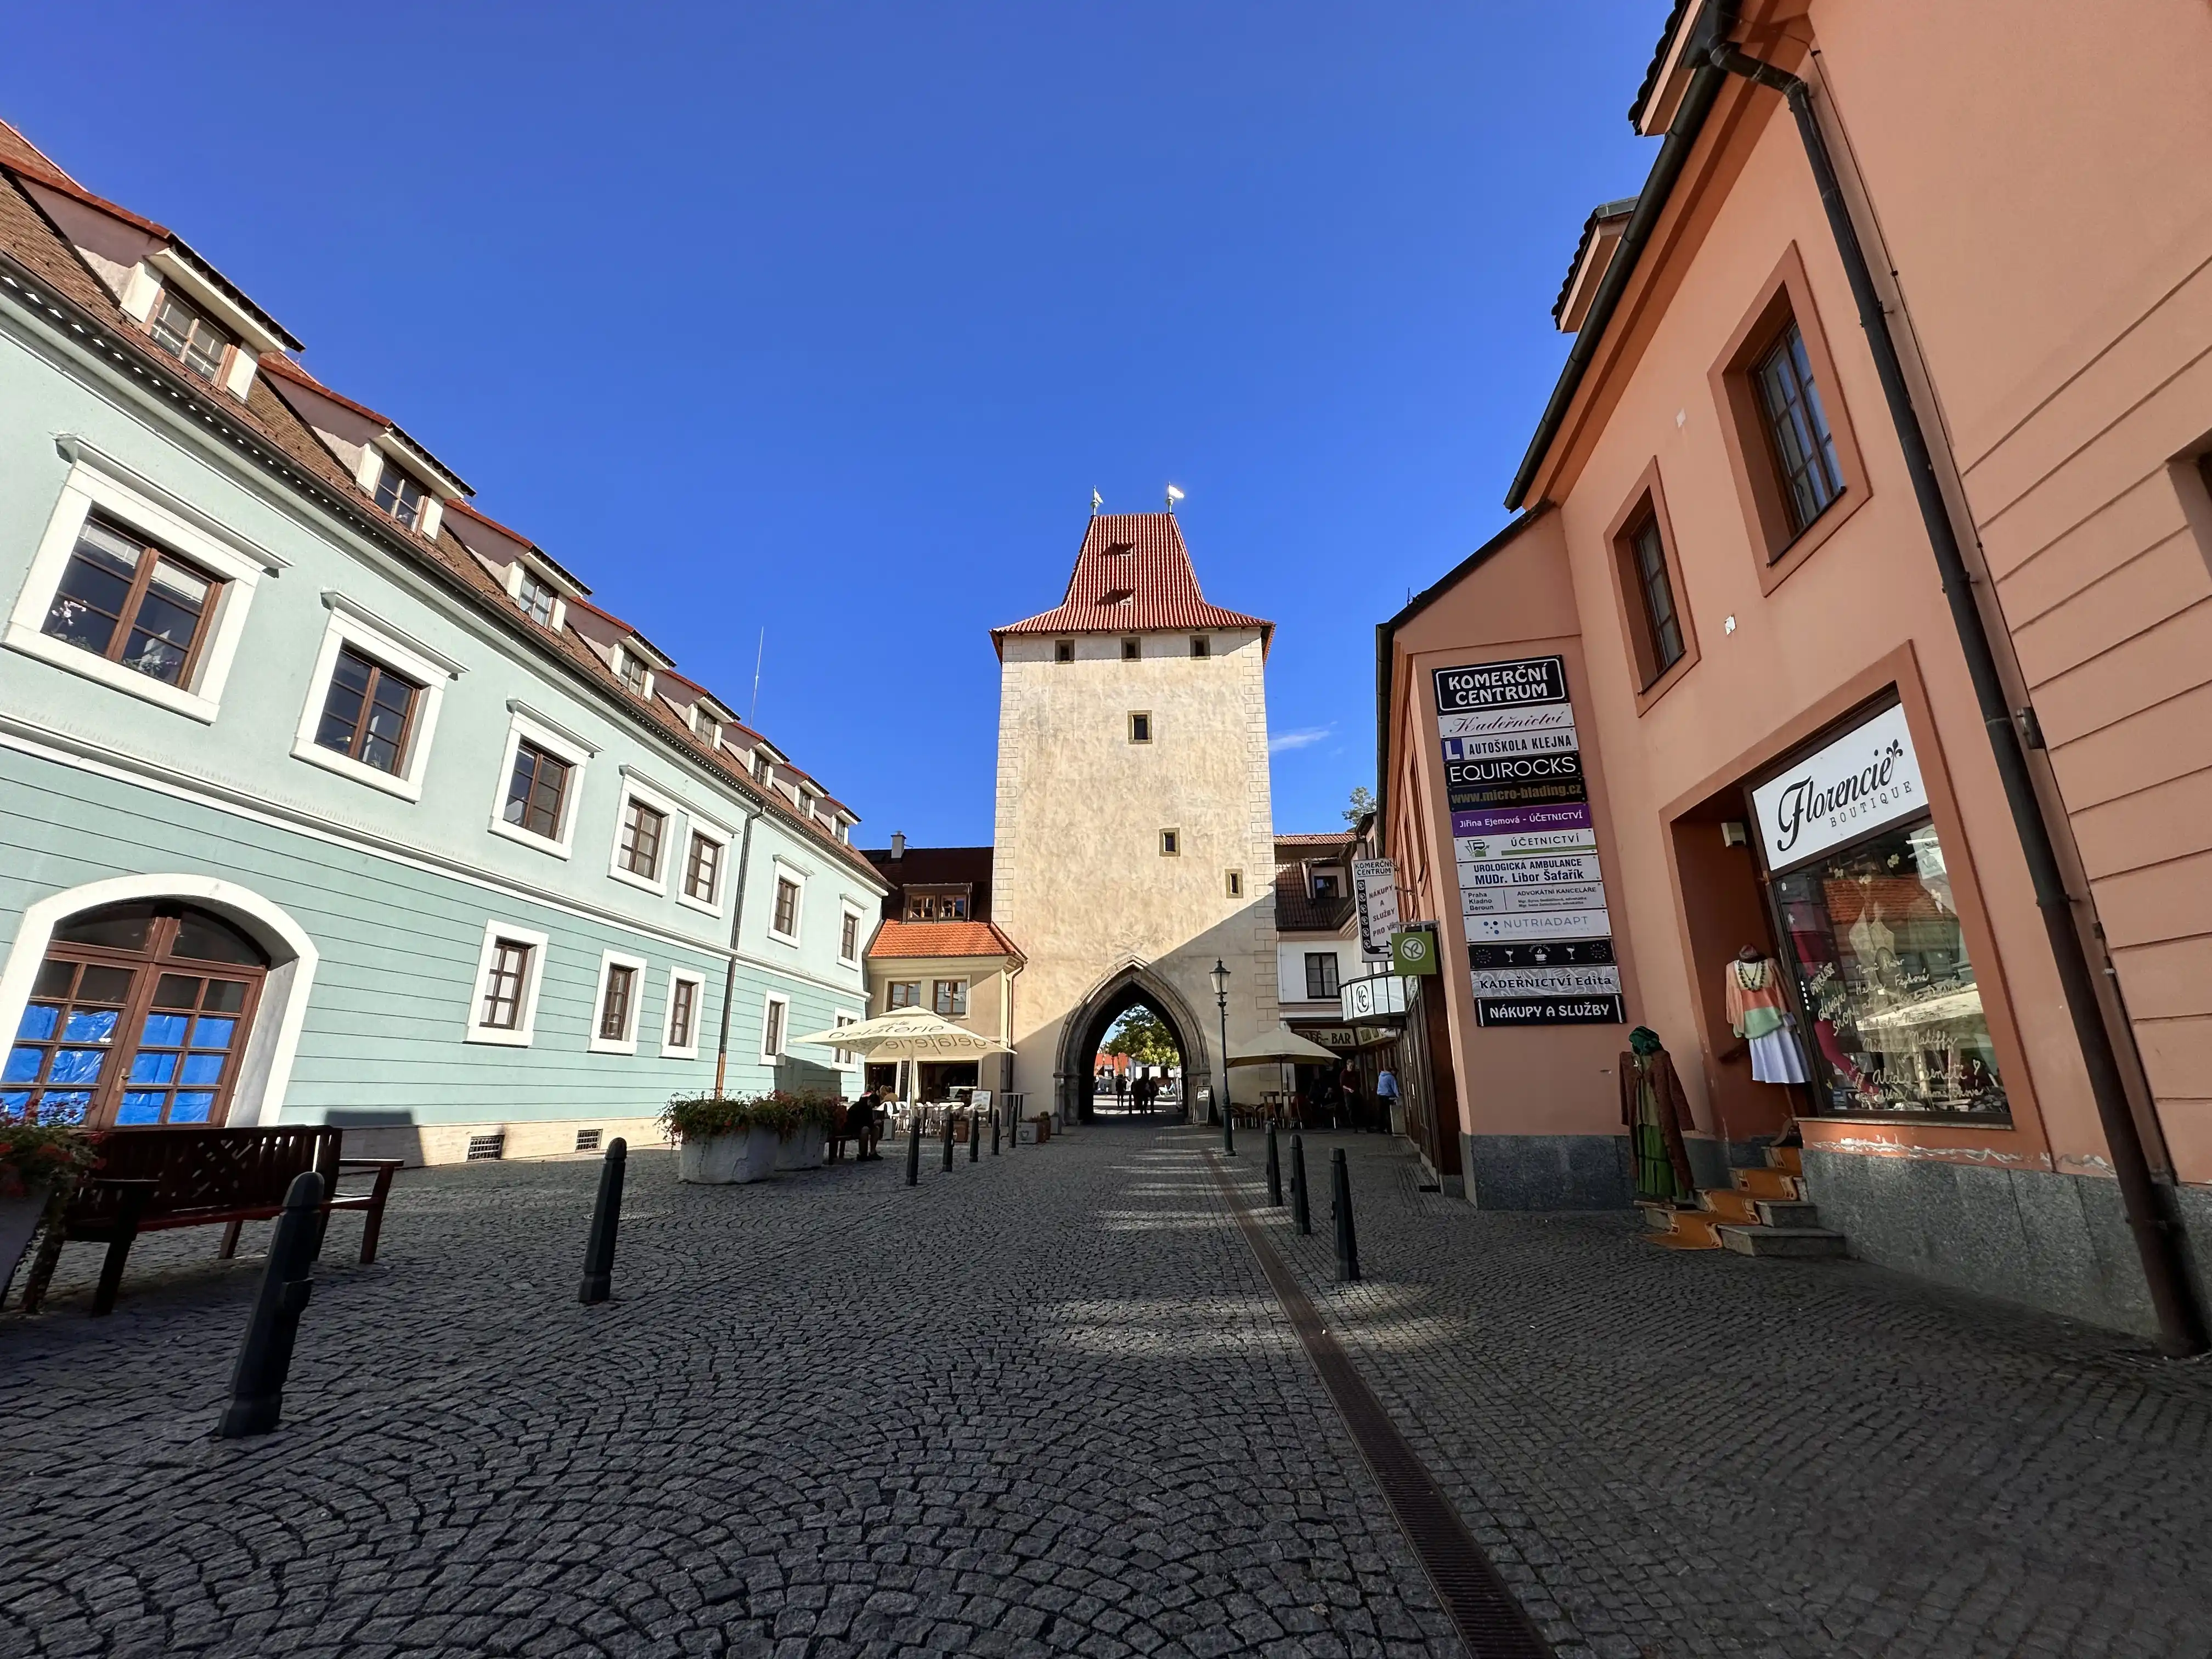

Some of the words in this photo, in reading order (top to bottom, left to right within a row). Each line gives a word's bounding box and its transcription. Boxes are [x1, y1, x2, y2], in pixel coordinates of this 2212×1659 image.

[1448, 663, 1549, 690] KOMERČNÍ
[1455, 683, 1548, 706] CENTRUM
[1449, 712, 1565, 733] Kadeřnictví
[1469, 739, 1528, 755] AUTOŠKOLA
[1532, 735, 1572, 750] KLEJNA
[1449, 757, 1576, 782] EQUIROCKS
[1451, 783, 1582, 804] www.micro-blading.cz
[1777, 749, 1895, 851] Florencie
[1830, 781, 1912, 827] BOUTIQUE
[1459, 819, 1482, 828] Jiřina
[1485, 815, 1520, 827] Ejemová
[1529, 810, 1583, 822] ÚČETNICTVÍ
[1510, 832, 1580, 847] ÚČETNICTVÍ
[1355, 860, 1393, 869] KOMERČNÍ
[1357, 867, 1391, 876] CENTRUM
[1473, 859, 1526, 873] UROLOGICKÁ
[1530, 858, 1582, 870] AMBULANCE
[1475, 872, 1508, 885] MUDr.
[1512, 871, 1540, 883] Libor
[1544, 868, 1584, 882] Šafařík
[1369, 884, 1393, 899] NÁKUPY
[1556, 886, 1596, 894] KANCELÁŘE
[1373, 907, 1395, 922] SLUŽBY
[1503, 916, 1589, 929] NUTRIADAPT
[1373, 927, 1385, 937] PRO
[1480, 975, 1571, 989] KADEŘNICTVÍ
[1576, 975, 1612, 986] Edita
[1489, 1004, 1542, 1019] NÁKUPY
[1546, 1006, 1555, 1017] A
[1559, 1001, 1610, 1017] SLUŽBY
[1331, 1033, 1351, 1045] BAR
